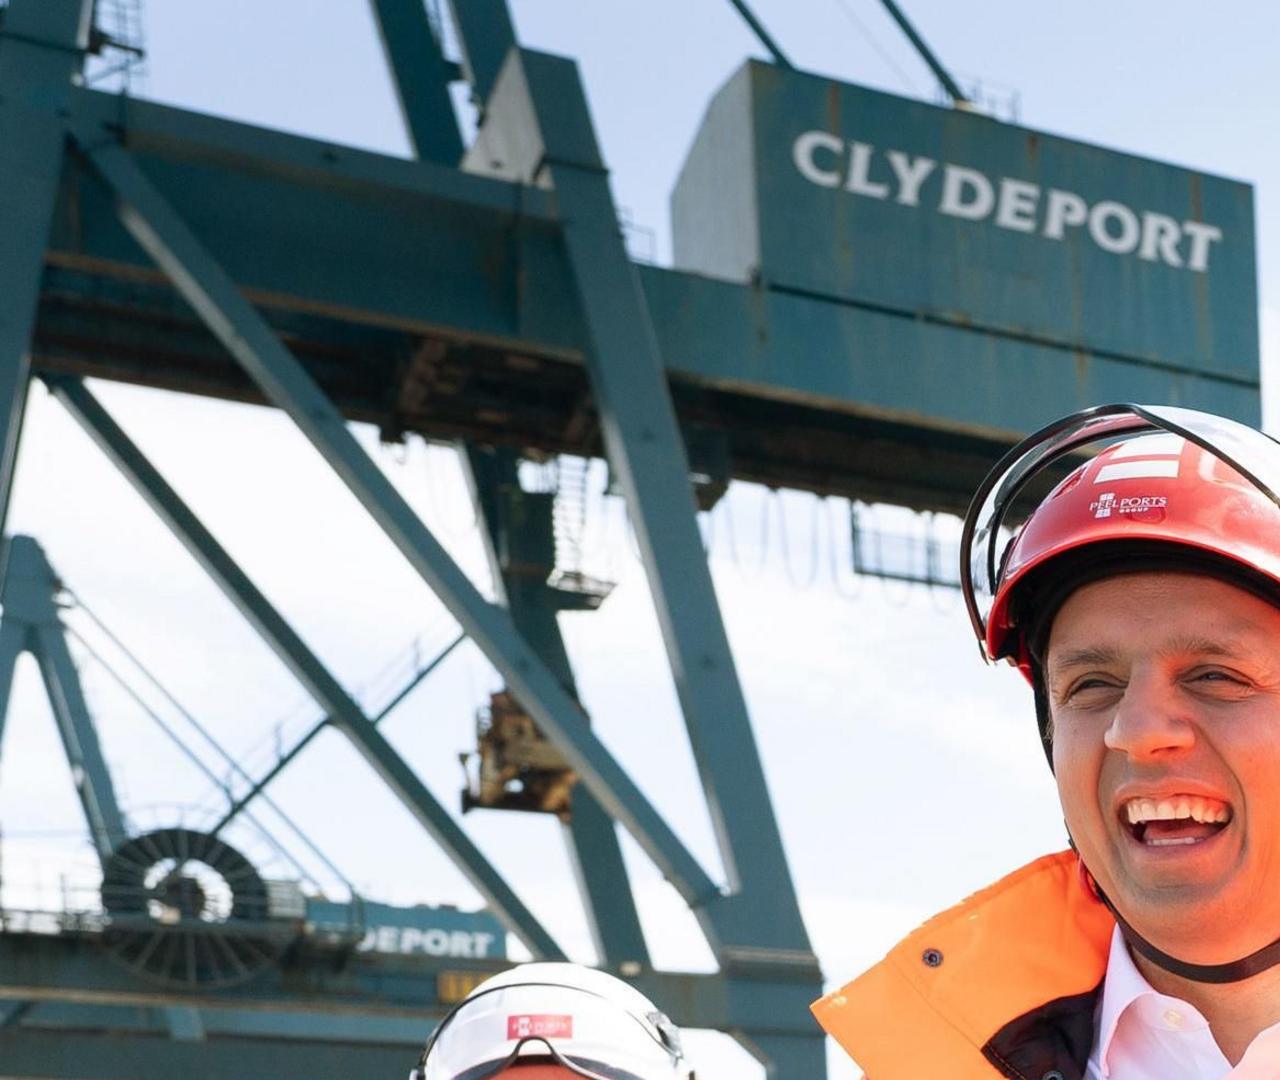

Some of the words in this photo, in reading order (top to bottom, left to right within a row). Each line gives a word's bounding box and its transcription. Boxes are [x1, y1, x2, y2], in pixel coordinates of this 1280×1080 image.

[792, 130, 1222, 273] CLYDEPORT
[1089, 500, 1119, 511] PEEL
[1120, 497, 1167, 507] PORTS
